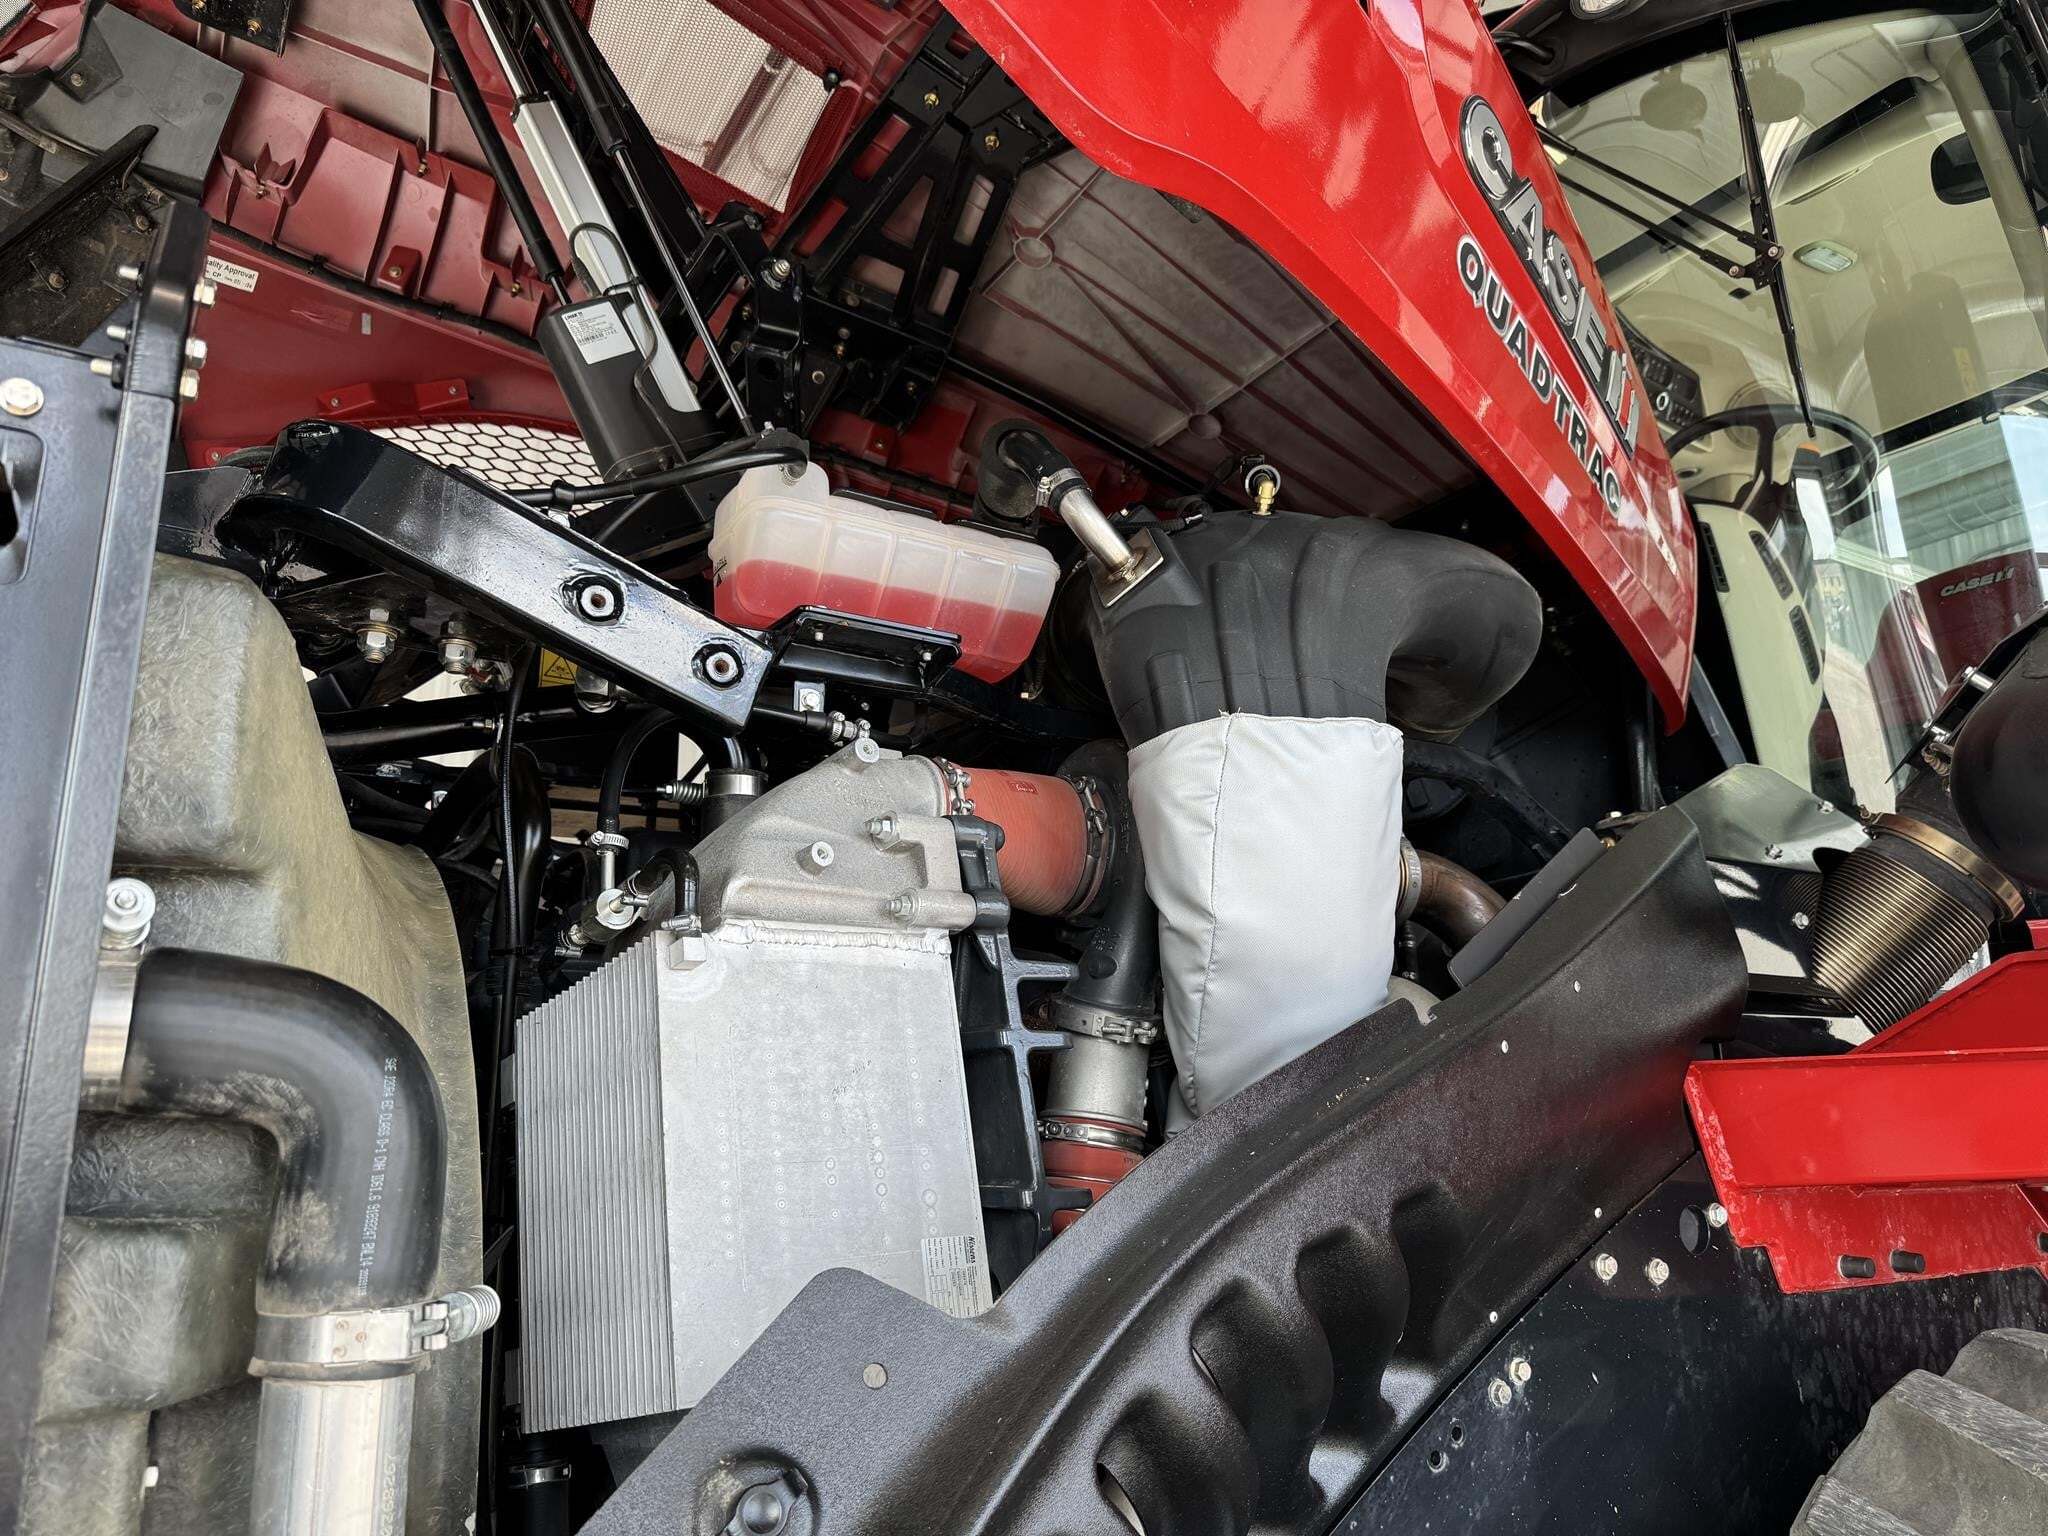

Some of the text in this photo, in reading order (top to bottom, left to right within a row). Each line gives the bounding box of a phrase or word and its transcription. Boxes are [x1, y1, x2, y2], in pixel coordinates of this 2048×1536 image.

[224, 265, 255, 280] Approval
[1457, 235, 1622, 518] QUADTRAC
[377, 1113, 393, 1137] CLASS
